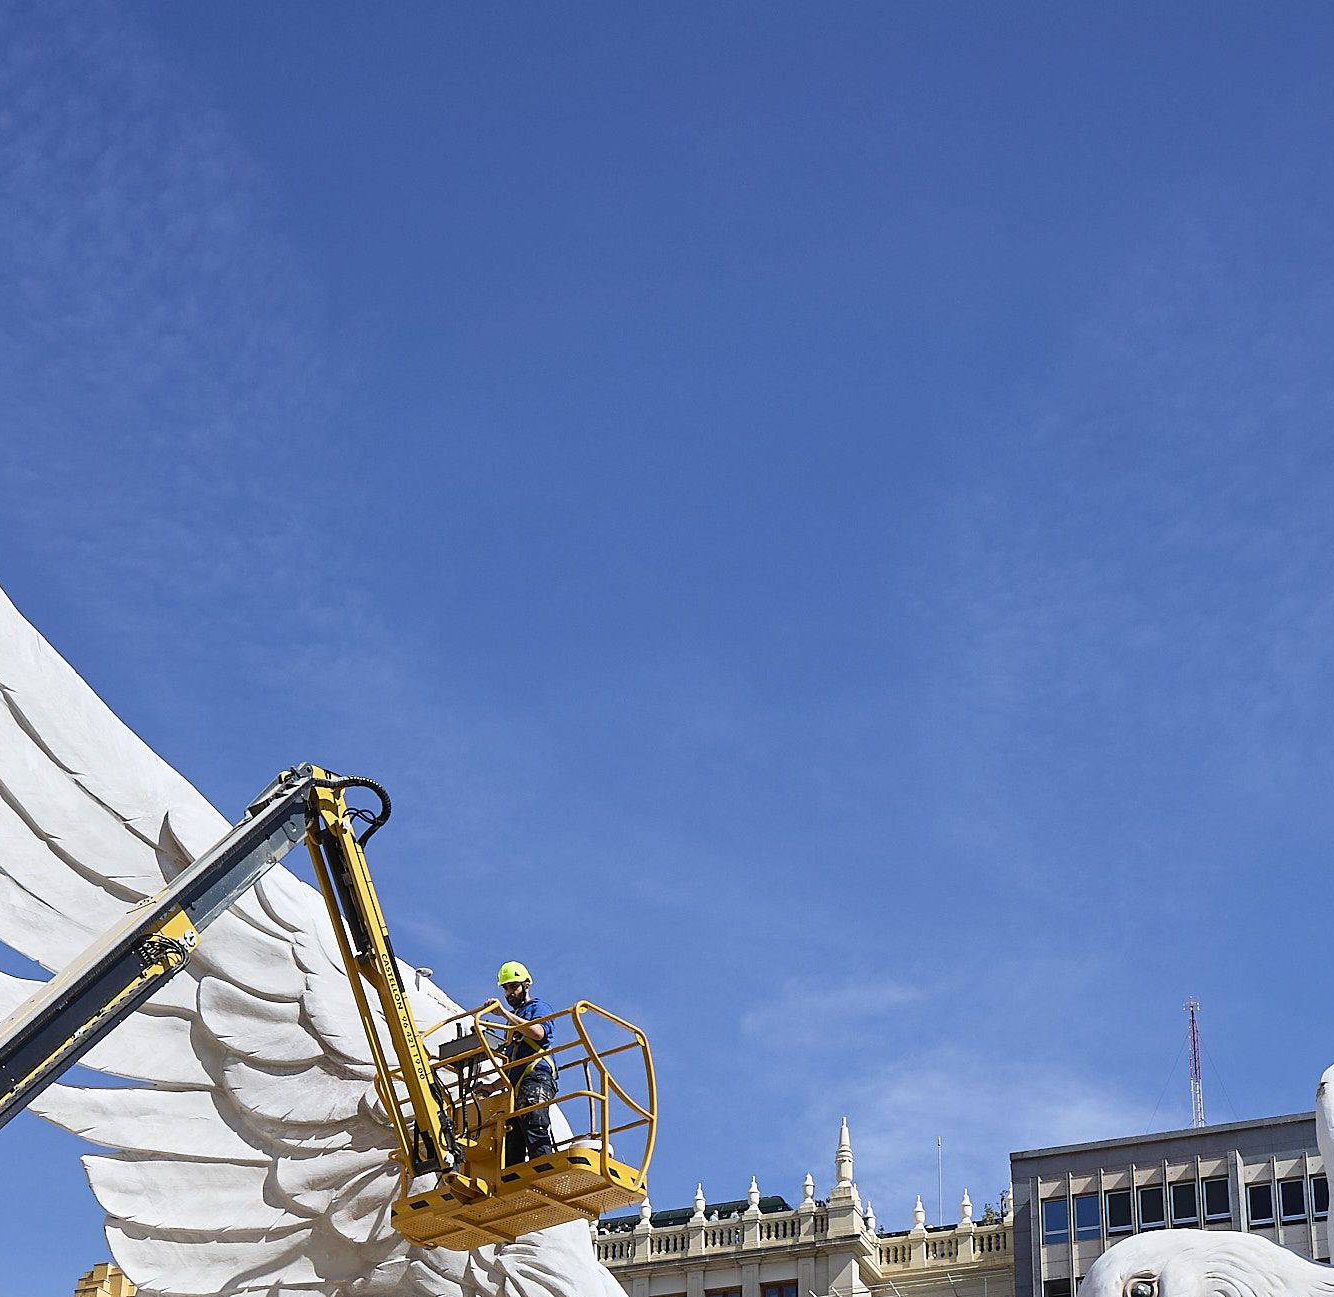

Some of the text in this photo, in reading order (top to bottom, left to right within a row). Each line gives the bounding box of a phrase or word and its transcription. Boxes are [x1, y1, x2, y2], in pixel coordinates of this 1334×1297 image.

[381, 953, 403, 1010] CASTELLON
[401, 1016, 408, 1029] 96
[406, 1031, 415, 1049] 421
[417, 1067, 426, 1080] 00
